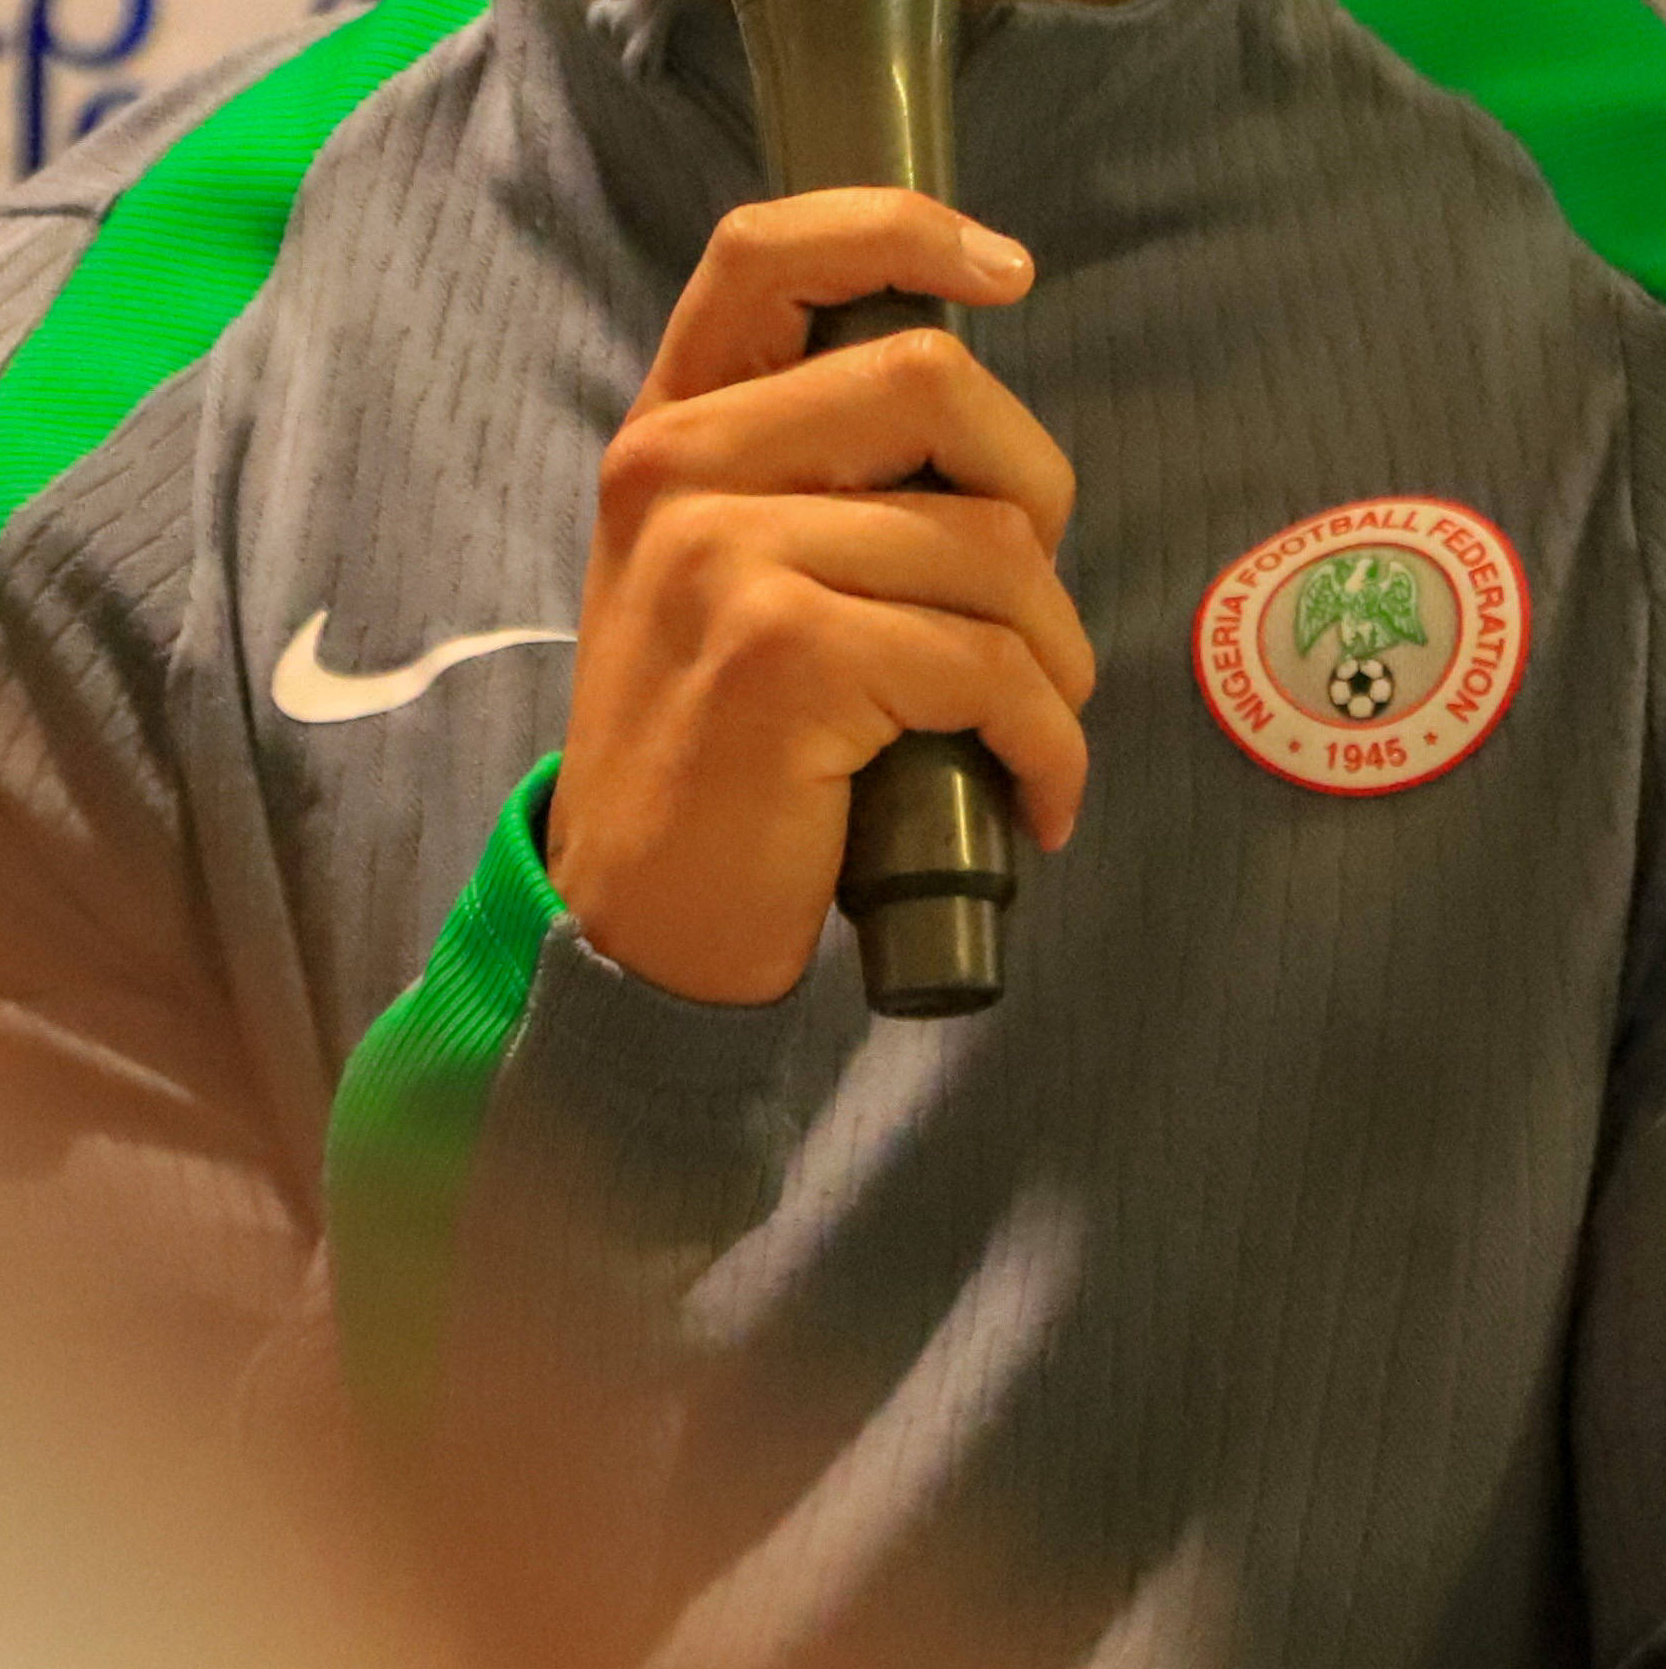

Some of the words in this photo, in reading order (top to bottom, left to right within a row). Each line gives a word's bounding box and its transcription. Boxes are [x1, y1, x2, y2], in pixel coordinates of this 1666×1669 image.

[1237, 509, 1423, 590] FOOTBALL
[1210, 591, 1275, 734] NIGERIA
[1427, 517, 1507, 724] FEDERATION
[1324, 737, 1408, 774] 1945
